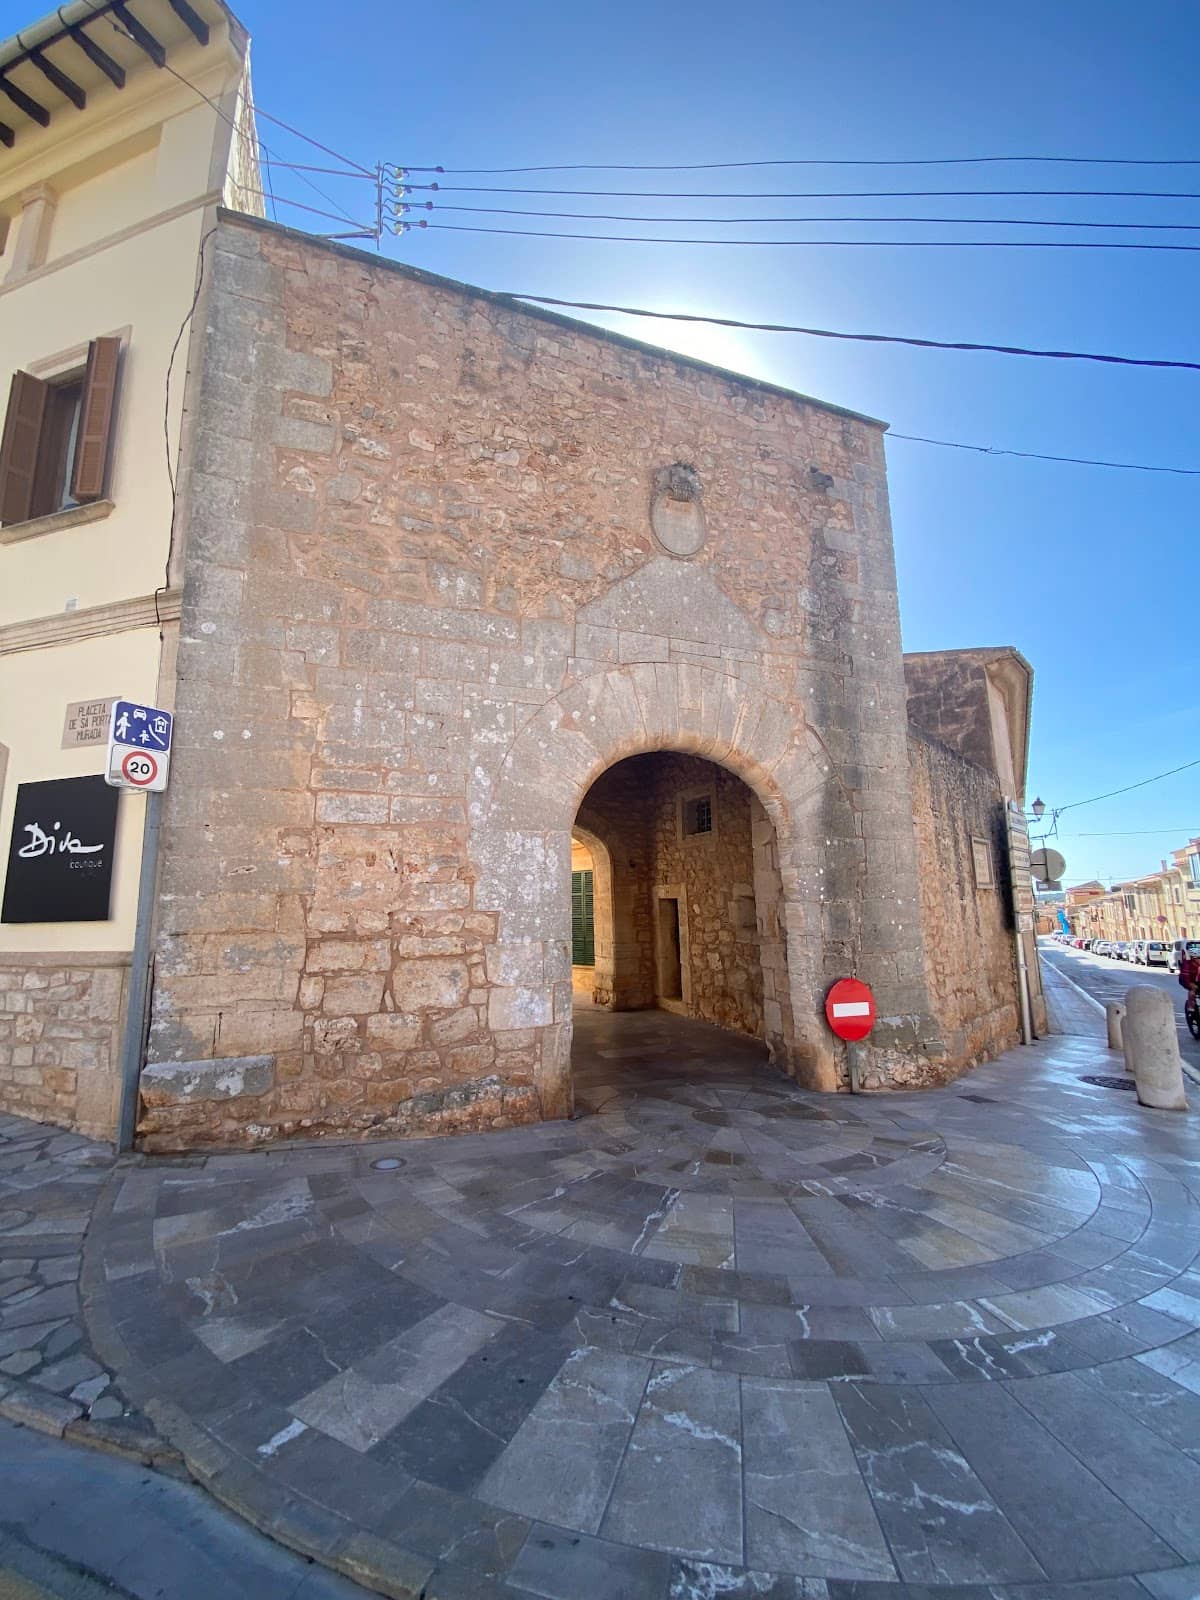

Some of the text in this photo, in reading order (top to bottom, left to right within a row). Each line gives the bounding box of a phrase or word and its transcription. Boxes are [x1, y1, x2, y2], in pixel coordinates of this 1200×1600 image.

[78, 703, 106, 718] PLACETA
[69, 718, 78, 730] DE
[80, 717, 89, 729] SA
[77, 728, 102, 741] MURADA
[130, 761, 150, 775] 20
[19, 822, 104, 857] Diva
